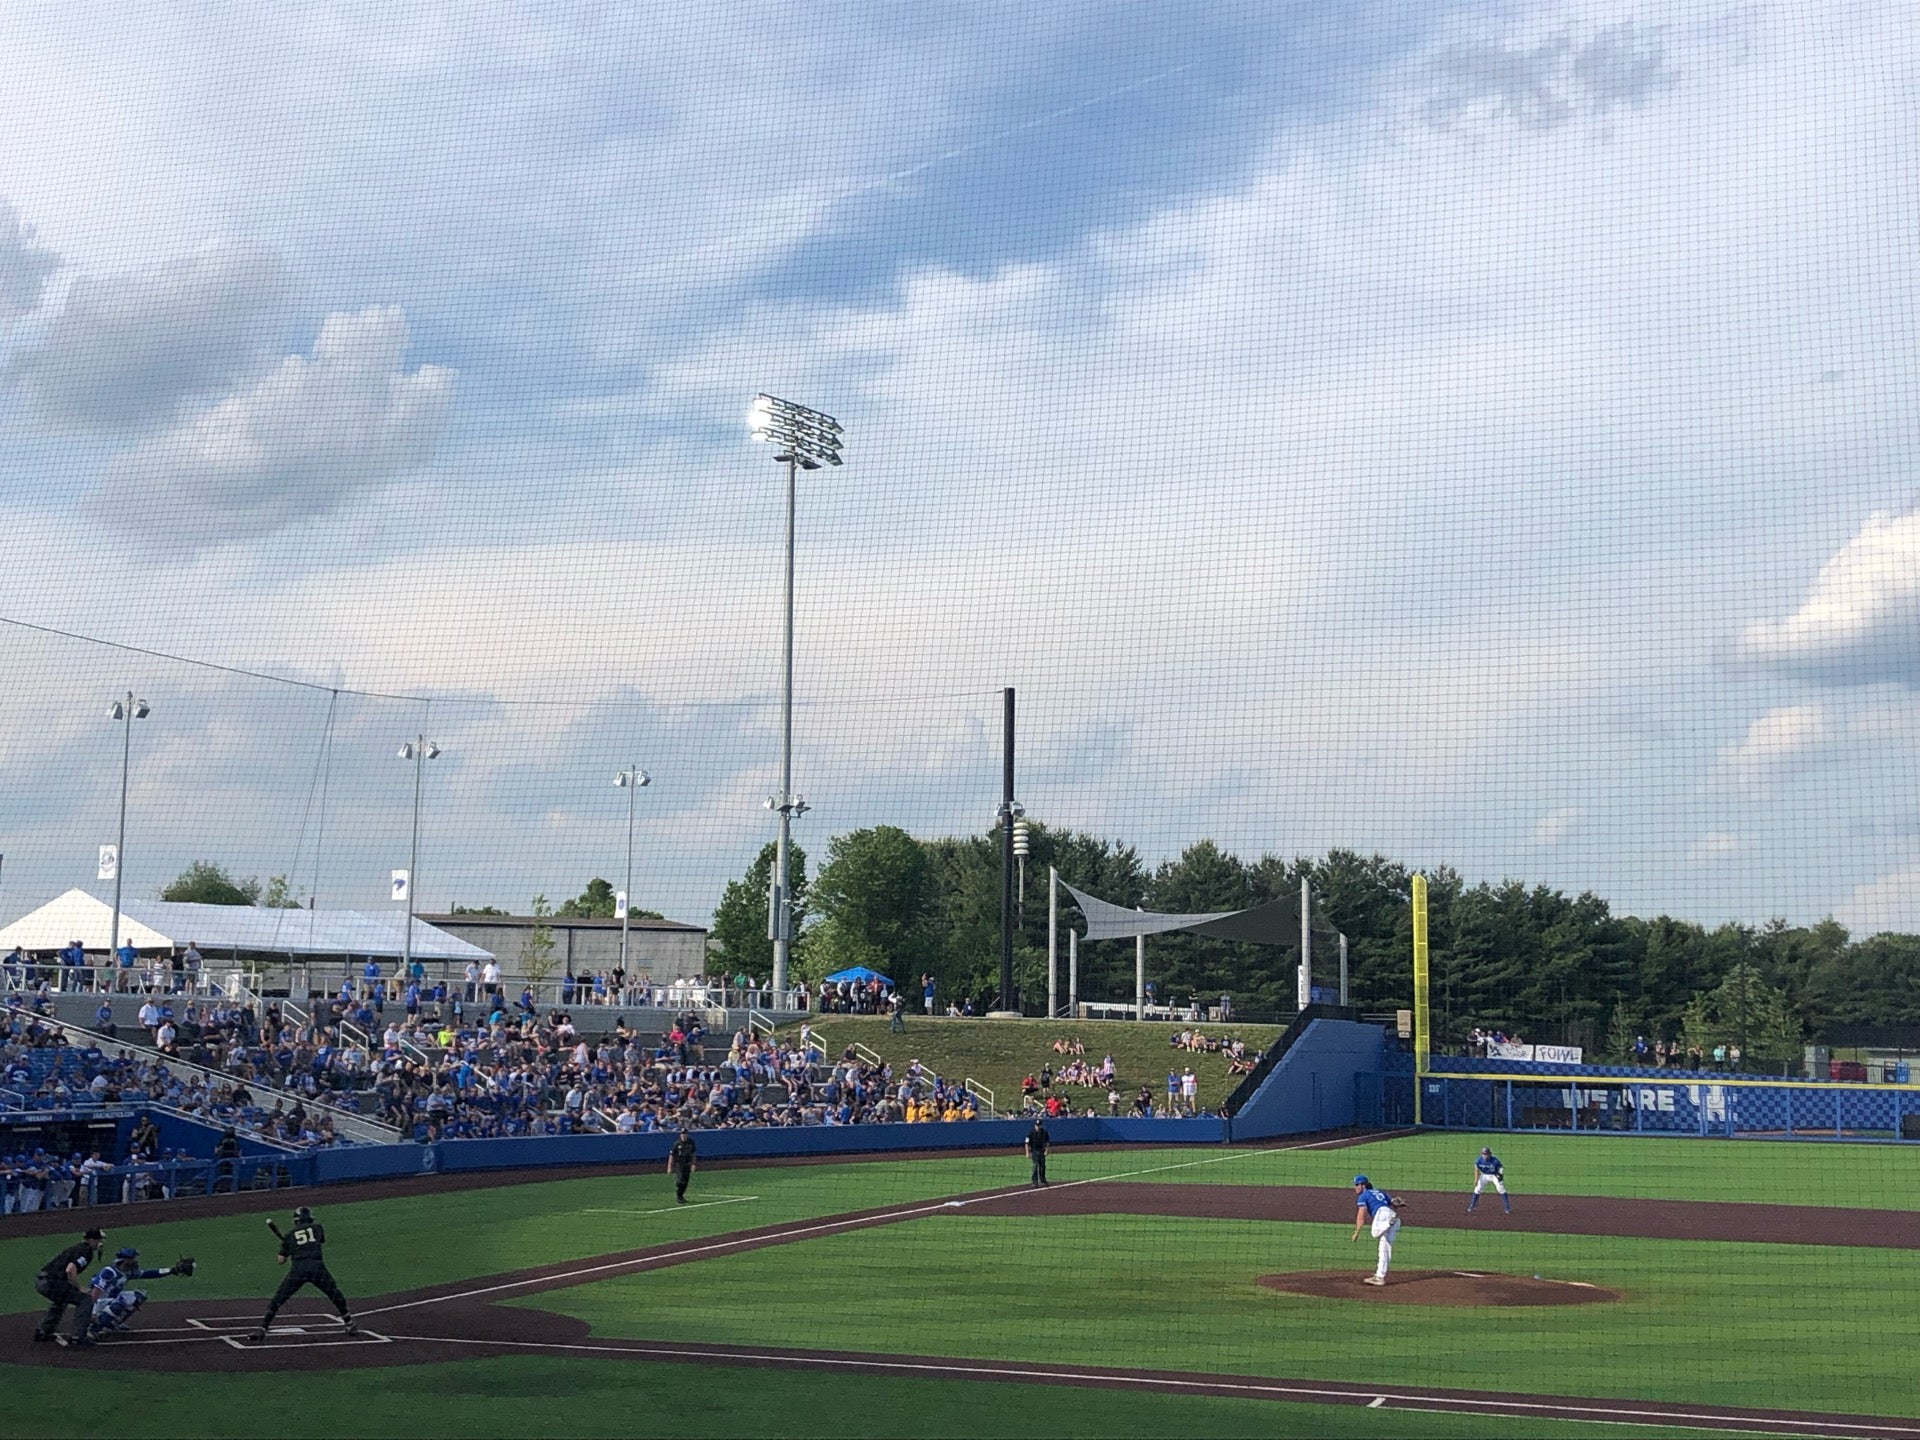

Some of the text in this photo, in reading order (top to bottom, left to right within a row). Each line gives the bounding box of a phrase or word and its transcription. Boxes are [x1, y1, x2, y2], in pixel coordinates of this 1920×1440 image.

[1539, 1046, 1578, 1062] FOWL
[1561, 1088, 1675, 1112] WE ARE
[294, 1227, 316, 1245] 51
